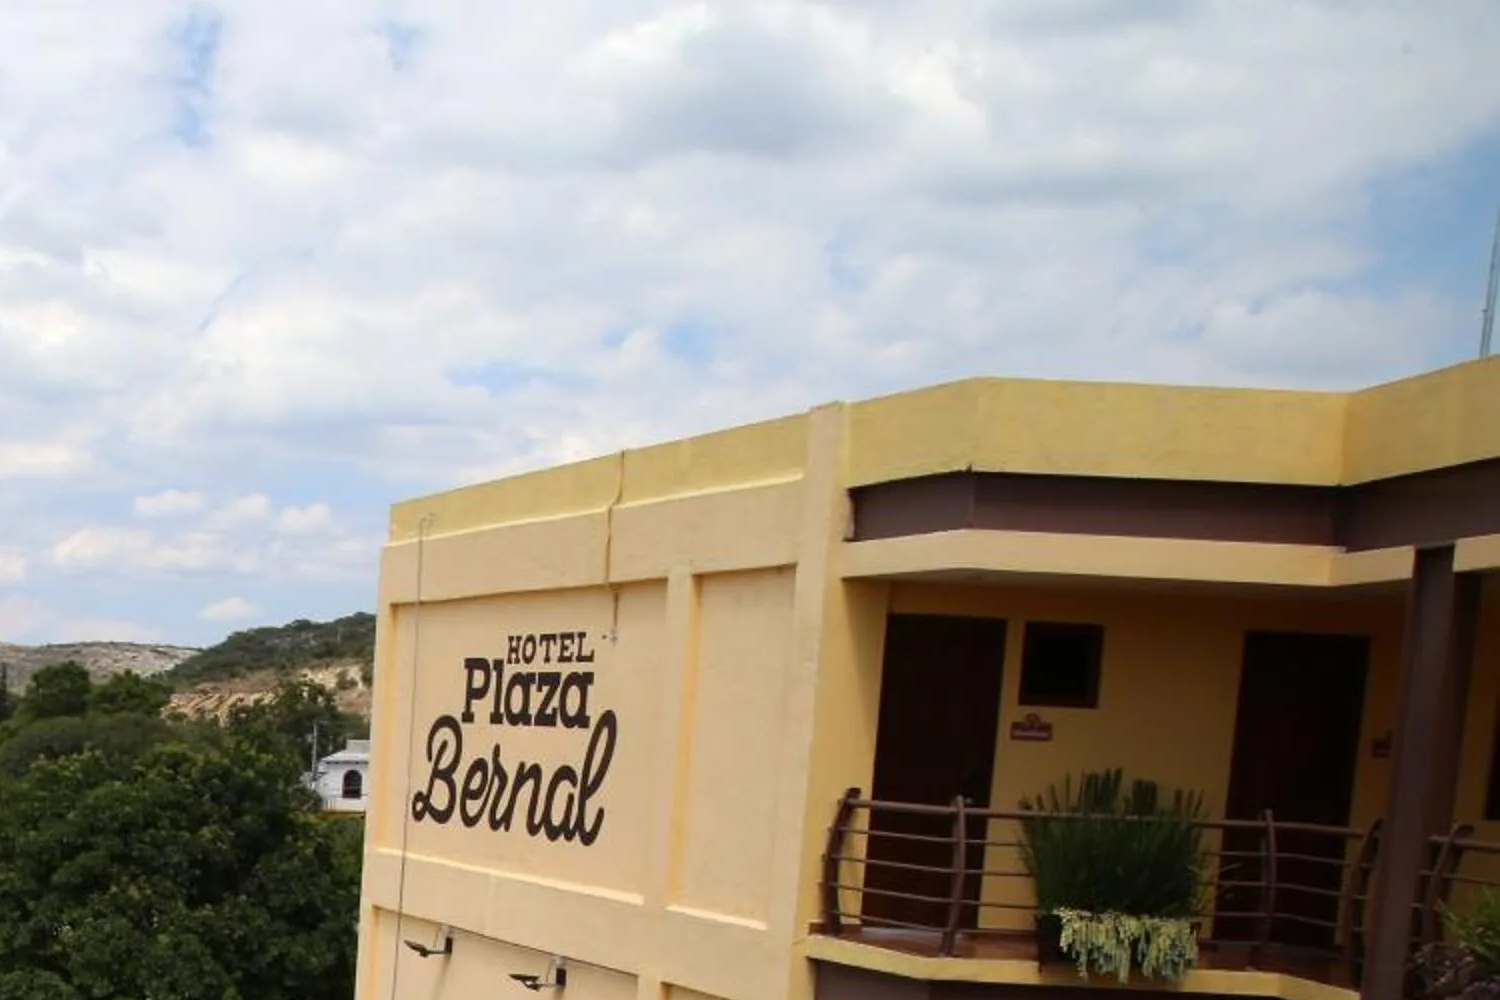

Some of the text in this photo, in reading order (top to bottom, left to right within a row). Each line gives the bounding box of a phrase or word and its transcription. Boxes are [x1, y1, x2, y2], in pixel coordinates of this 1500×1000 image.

[506, 631, 595, 665] HOTEL
[461, 657, 595, 729] Plaza
[411, 709, 617, 846] Bernal
